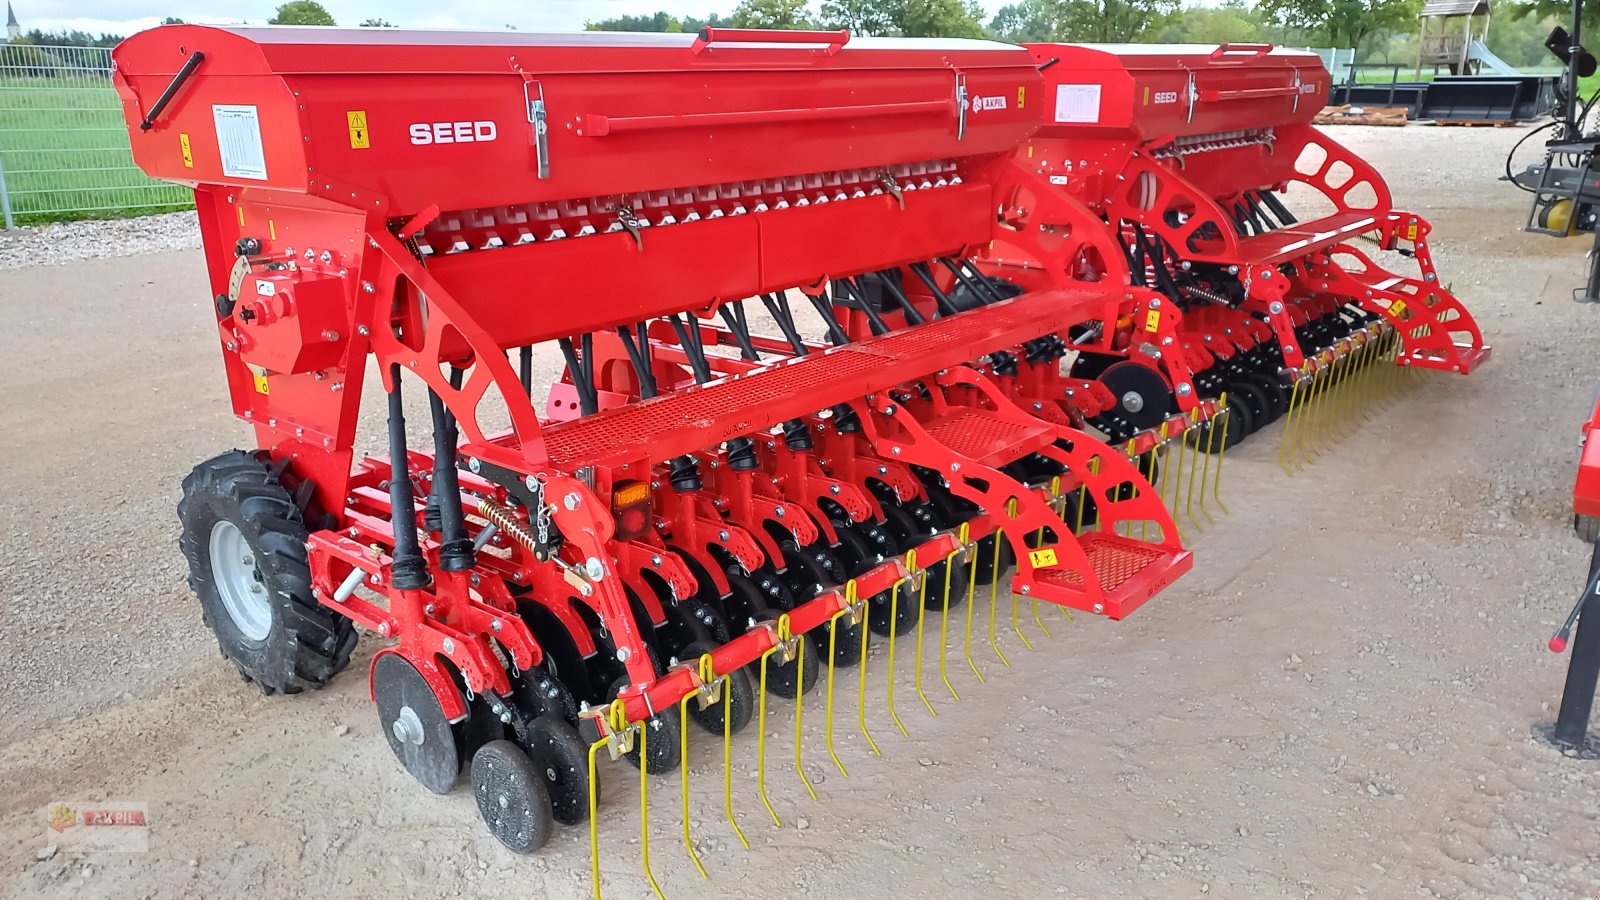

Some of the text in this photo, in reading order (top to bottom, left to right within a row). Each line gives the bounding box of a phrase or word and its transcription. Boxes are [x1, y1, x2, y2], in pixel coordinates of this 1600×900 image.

[984, 97, 1005, 108] AKPIL
[1155, 92, 1177, 103] SEED
[409, 121, 497, 145] SEED
